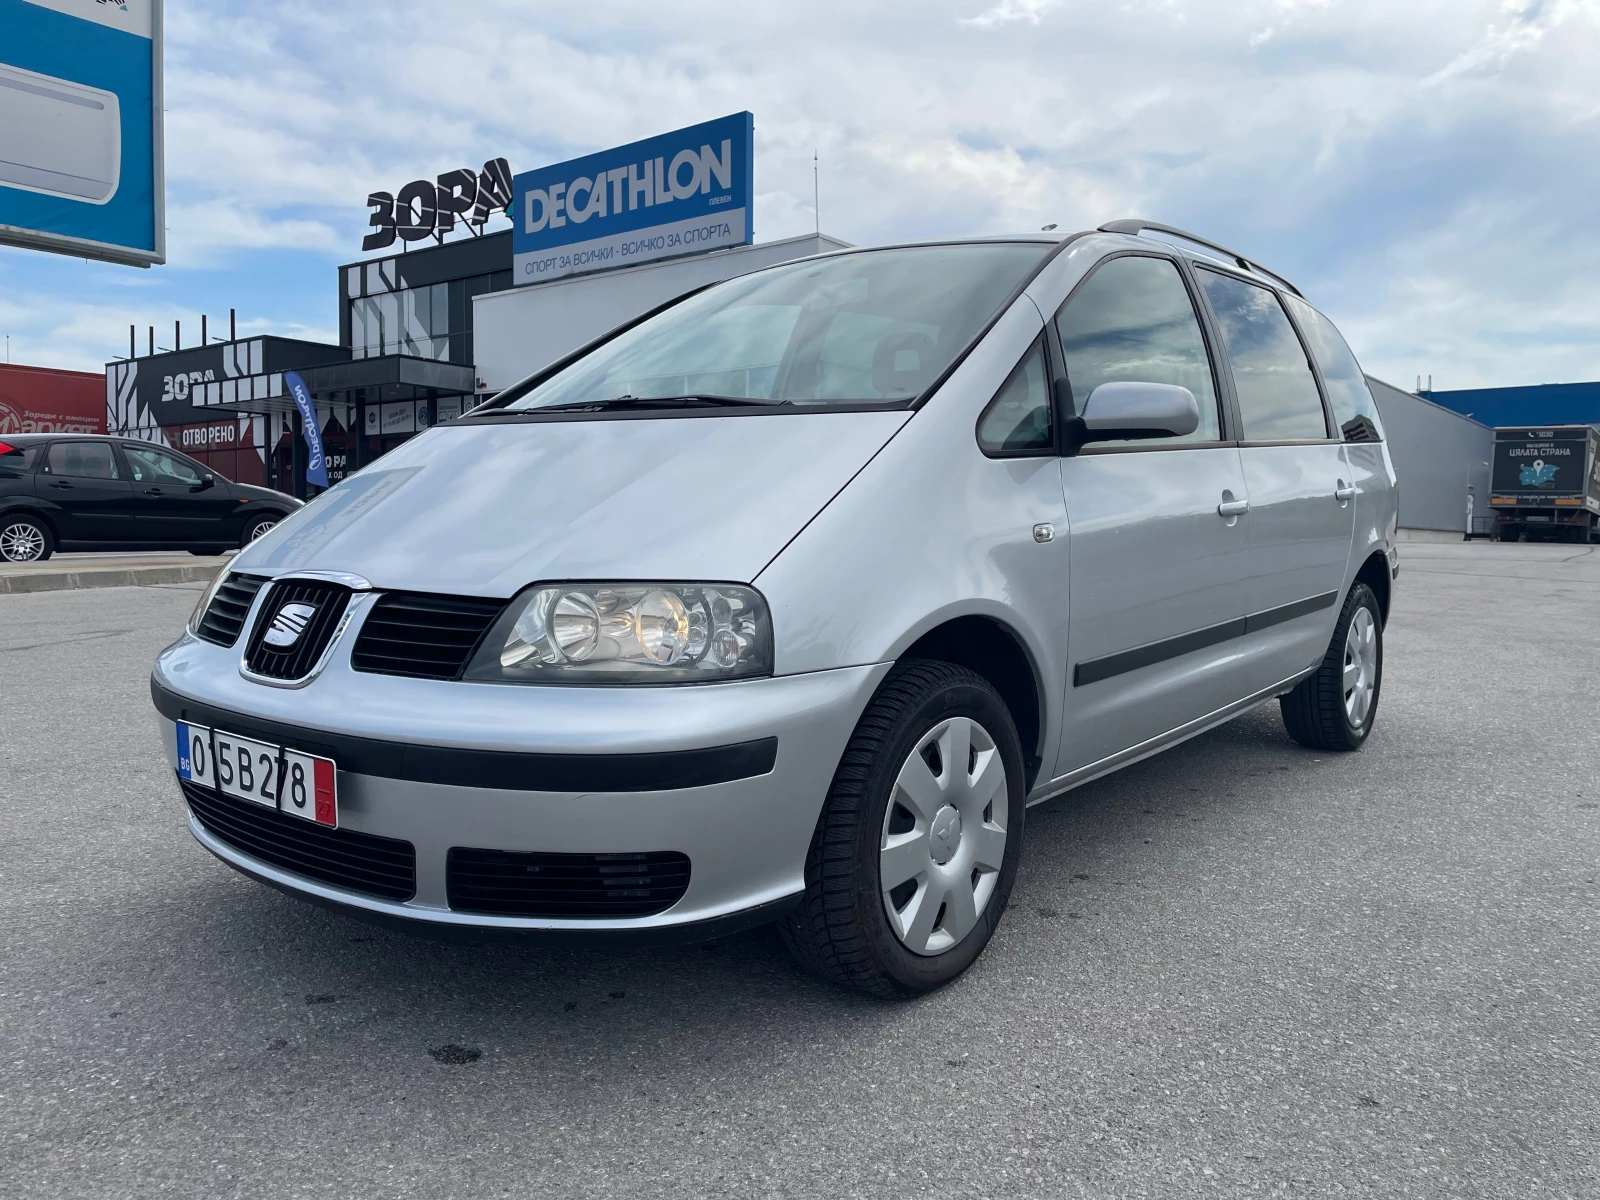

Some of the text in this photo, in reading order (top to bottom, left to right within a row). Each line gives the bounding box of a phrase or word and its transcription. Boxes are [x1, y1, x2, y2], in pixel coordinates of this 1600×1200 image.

[525, 139, 731, 234] DECATHLON
[362, 157, 514, 251] ЗОРА
[708, 195, 732, 206] ПЛЕВЕН
[525, 258, 557, 275] СПОРТ
[559, 255, 572, 269] ЗА
[573, 246, 613, 266] ВСИЧКИ
[621, 236, 665, 256] ВСИЧКО
[667, 233, 681, 247] ЗА
[684, 223, 731, 244] СПОРТА
[23, 410, 57, 420] Зареди
[182, 425, 235, 446] ОТВОРЕНО
[1509, 448, 1571, 457] ЦЯЛАТА СТРАНА
[180, 757, 190, 772] BG
[192, 734, 307, 809] 05B28
[318, 800, 331, 818] 27
